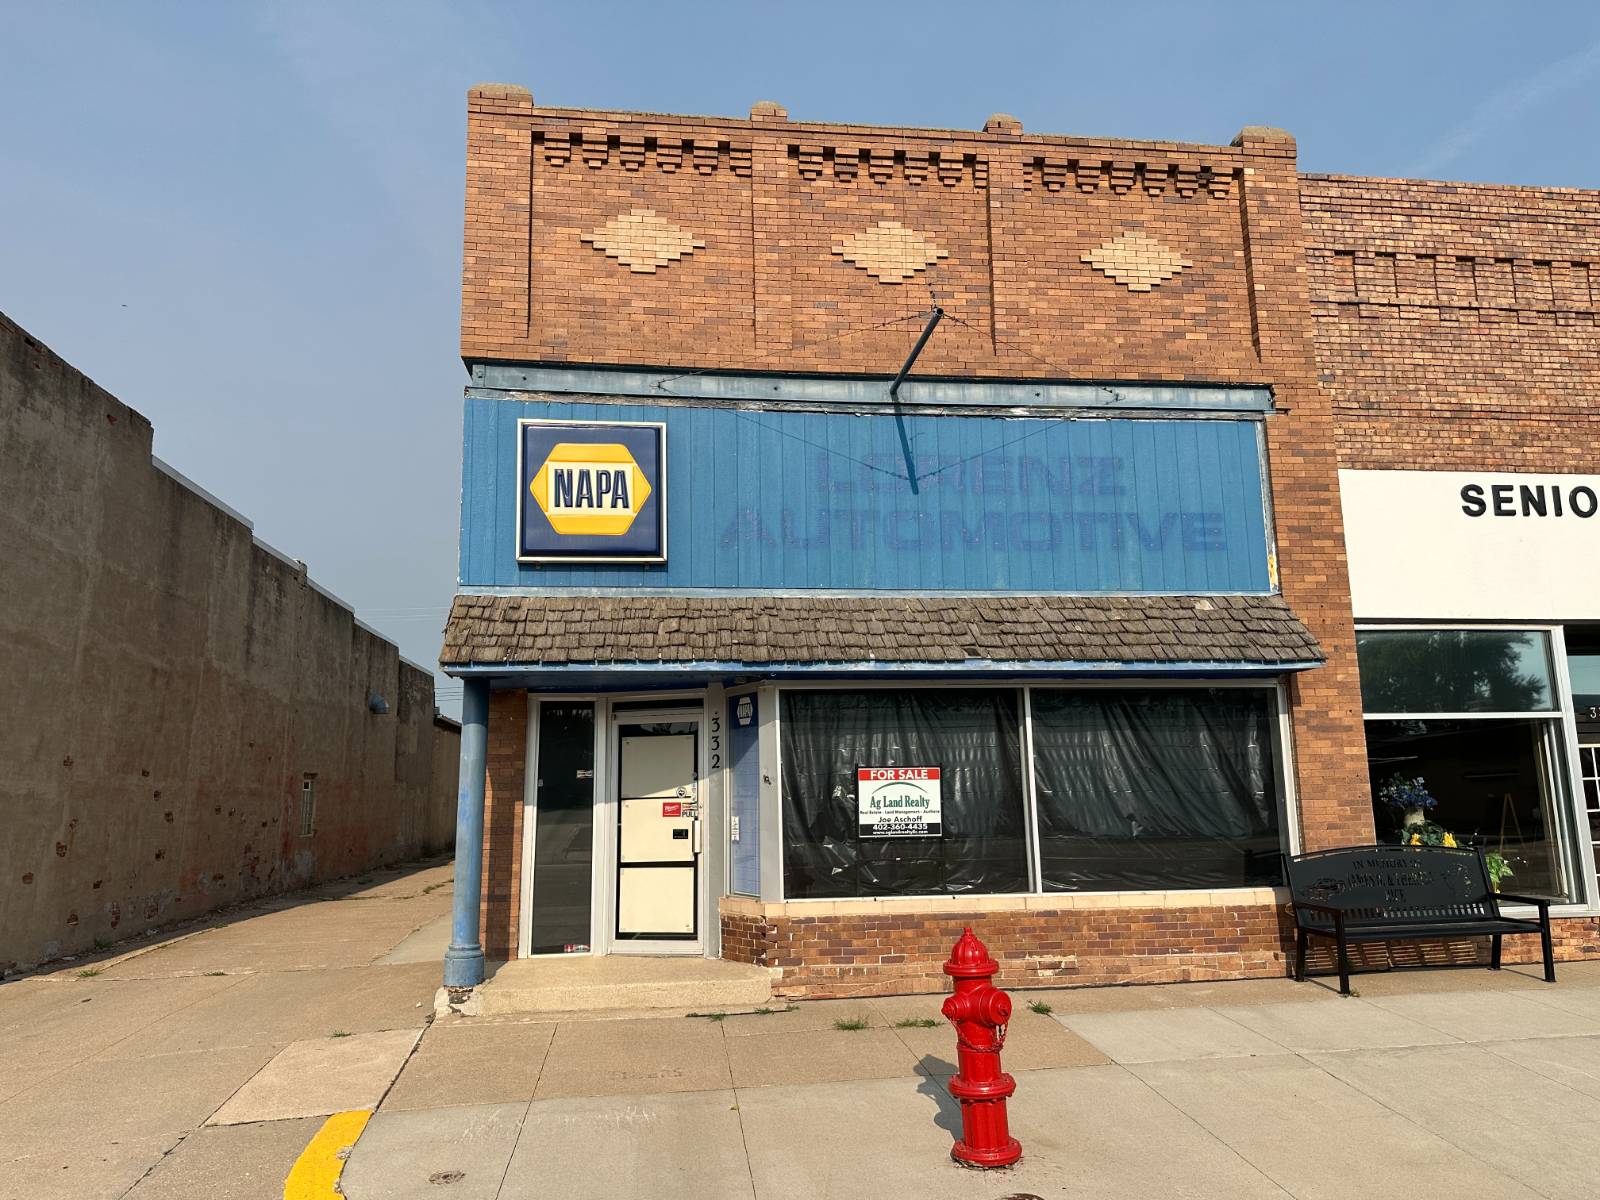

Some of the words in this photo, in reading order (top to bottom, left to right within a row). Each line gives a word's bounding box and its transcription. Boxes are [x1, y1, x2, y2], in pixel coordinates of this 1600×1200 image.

[553, 468, 630, 509] NAPA
[1460, 484, 1598, 518] SENIO
[720, 507, 1226, 551] AUTOMOTIVE
[711, 717, 720, 769] 332
[870, 769, 895, 780] FOR
[898, 769, 928, 780] SALE
[870, 796, 881, 810] Ag
[883, 795, 903, 808] Land
[905, 795, 930, 809] Realty
